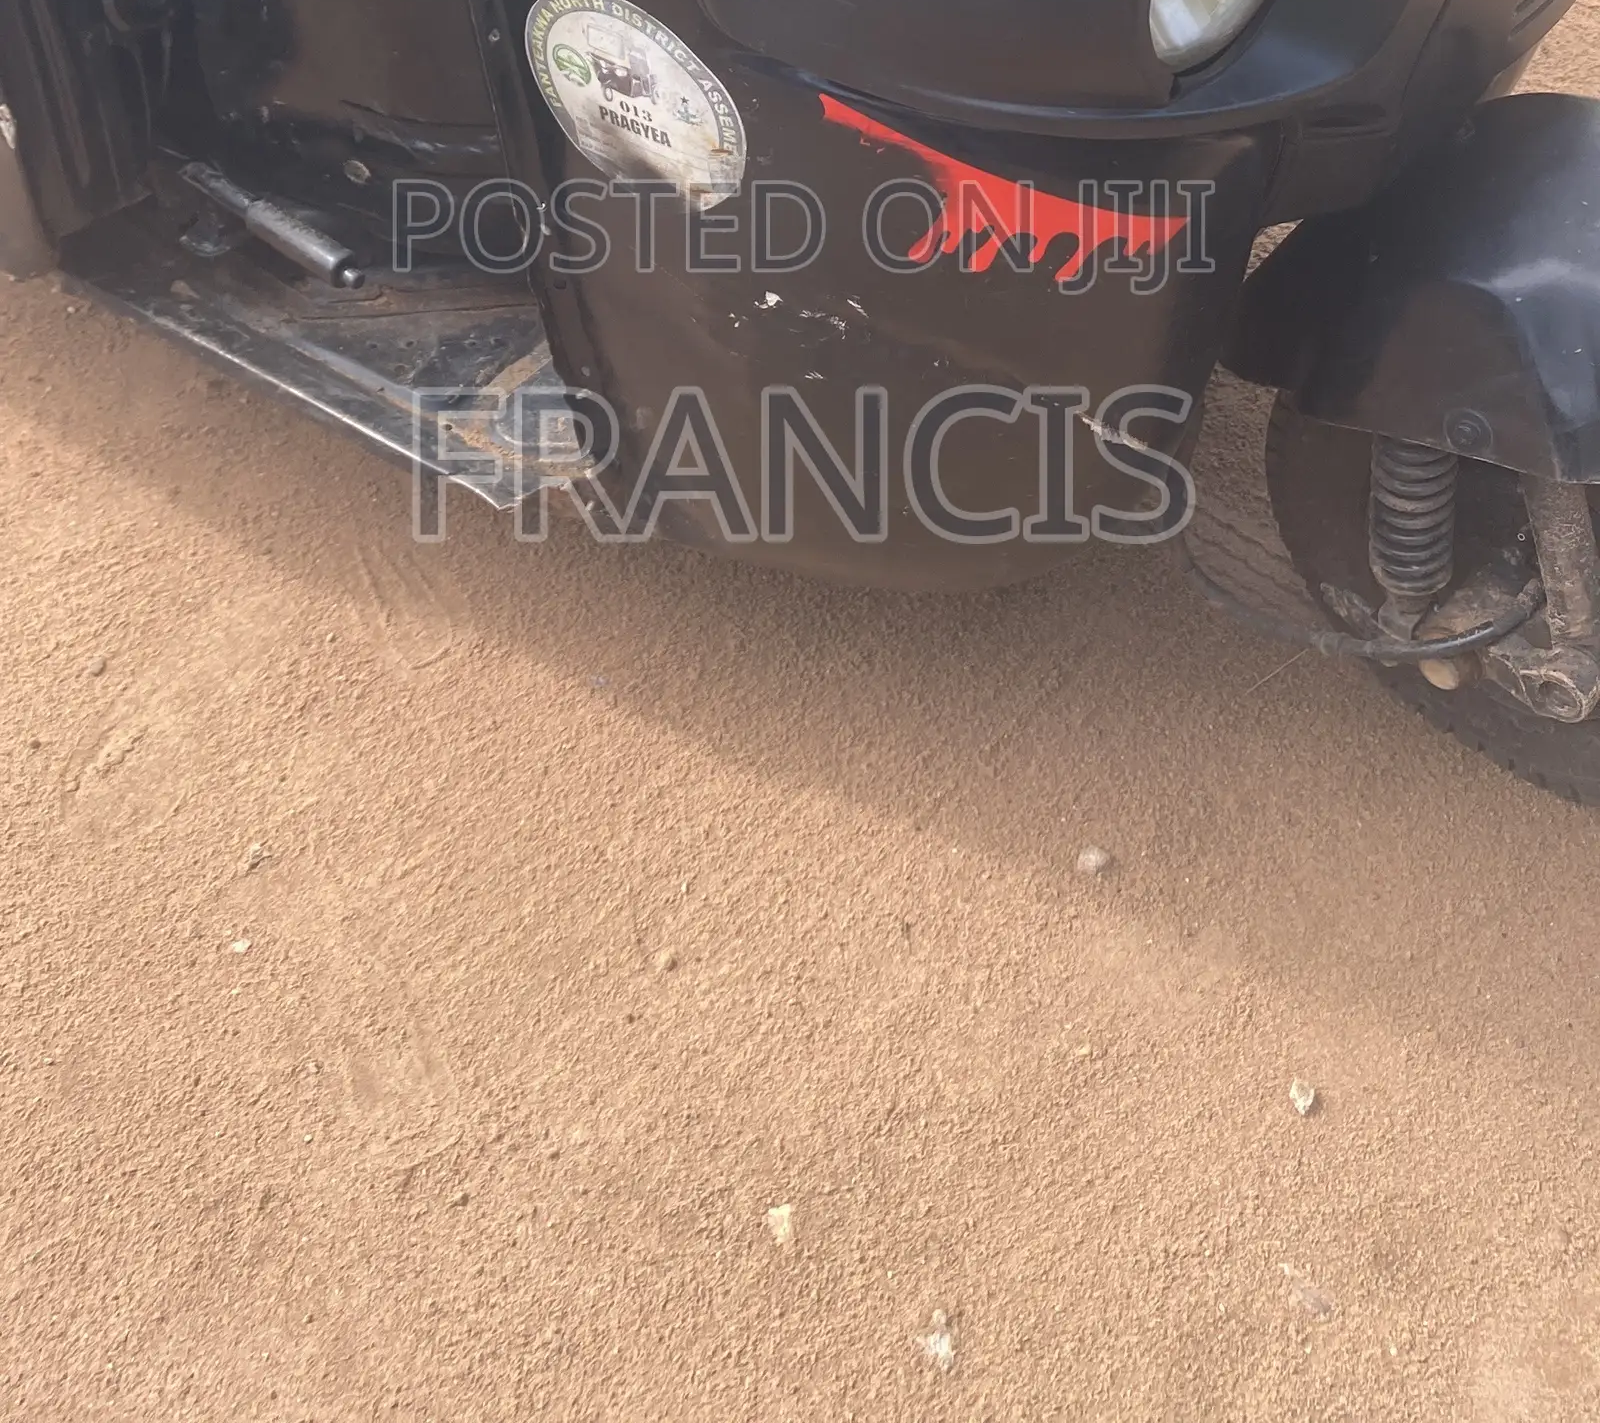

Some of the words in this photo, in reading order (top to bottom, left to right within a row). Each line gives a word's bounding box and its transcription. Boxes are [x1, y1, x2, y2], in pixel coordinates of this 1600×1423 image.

[532, 8, 562, 108] FANTEAKWA
[611, 2, 702, 72] DISTRICT
[599, 105, 672, 148] PRAGYEA
[619, 100, 652, 123] 013
